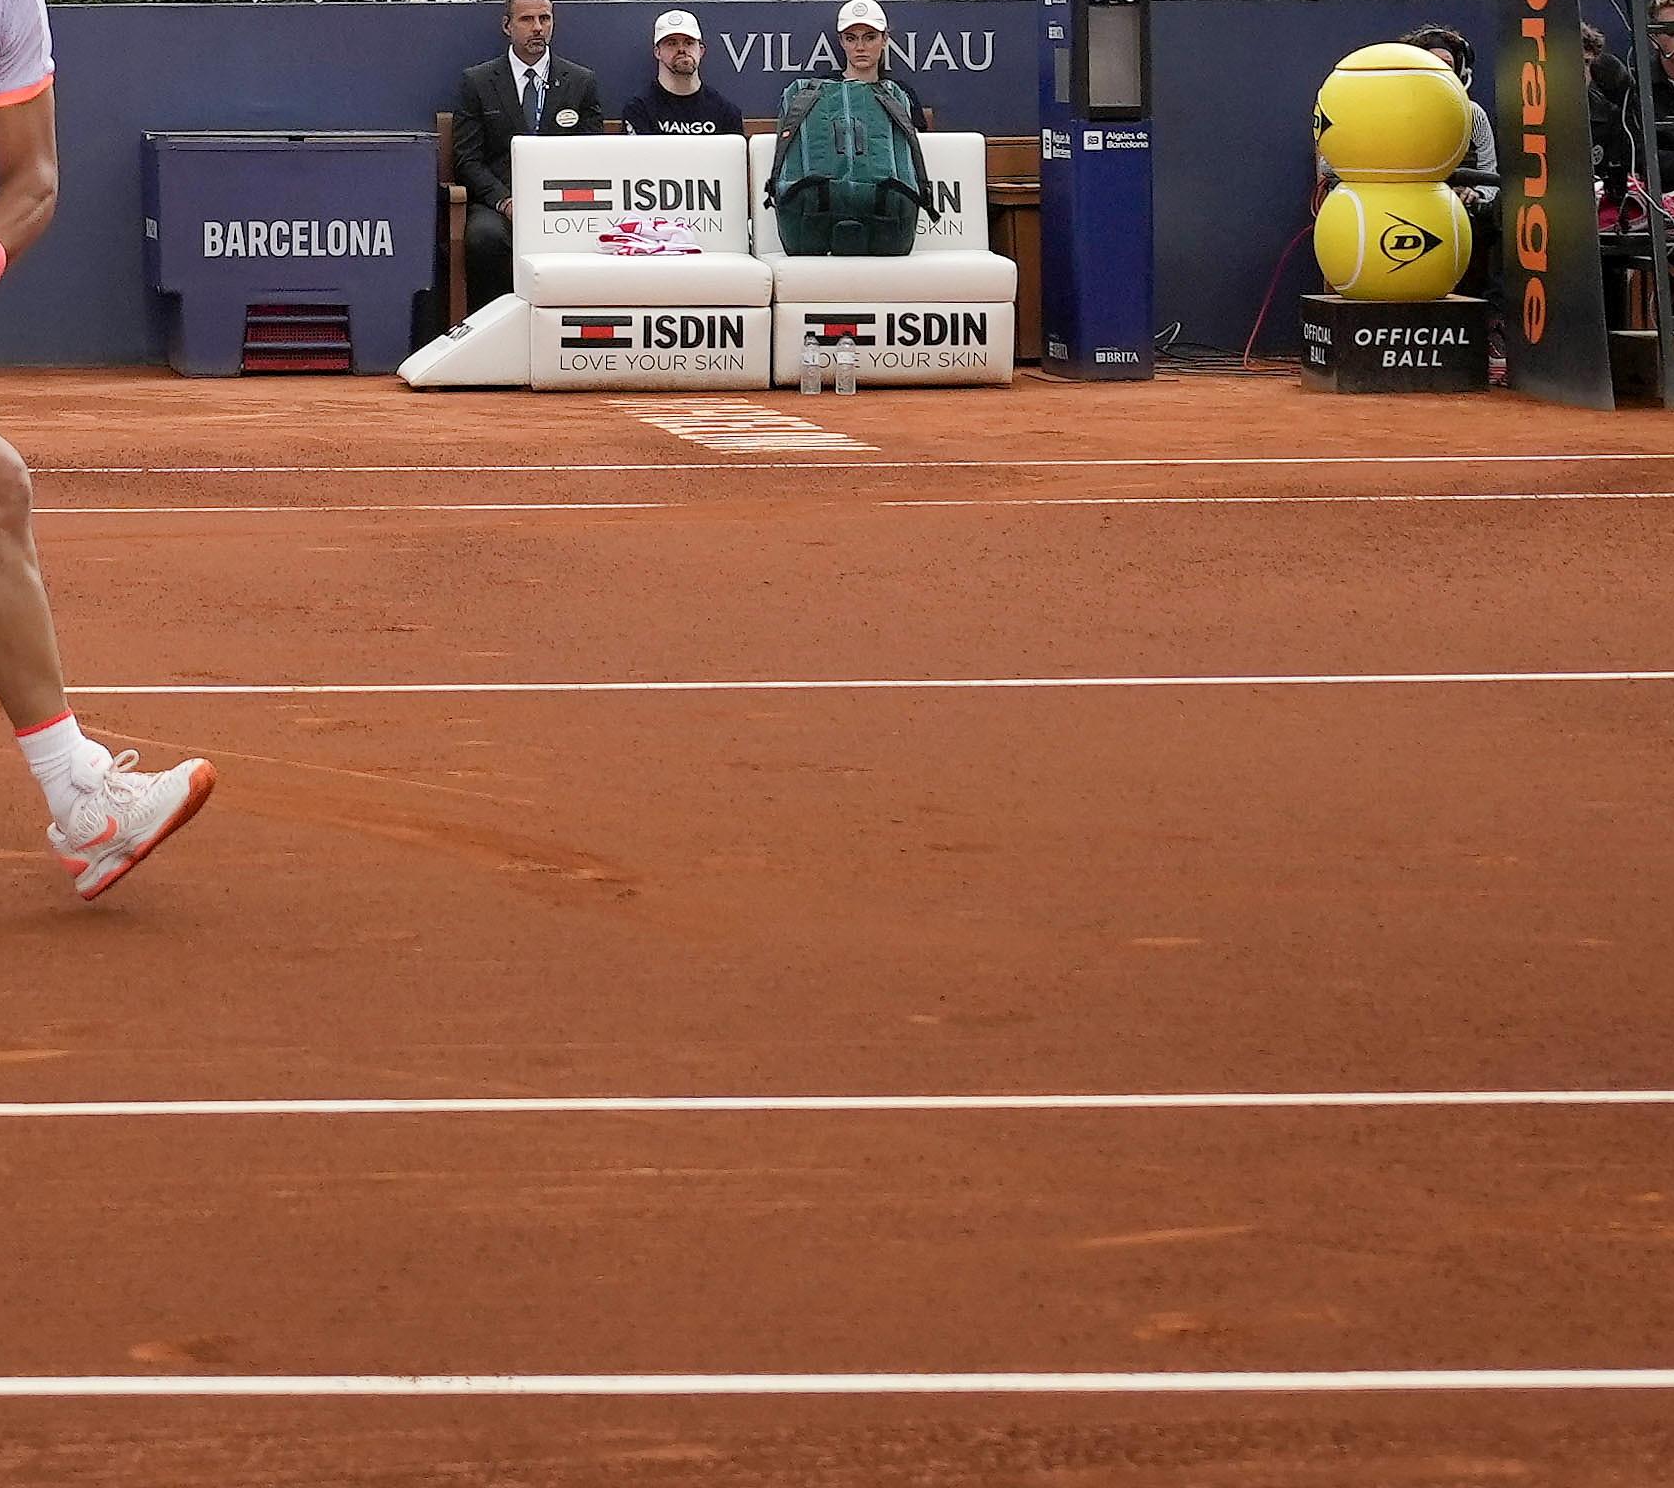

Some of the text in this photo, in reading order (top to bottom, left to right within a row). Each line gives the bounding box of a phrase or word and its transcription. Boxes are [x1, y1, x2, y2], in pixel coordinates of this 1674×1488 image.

[720, 30, 995, 72] VILANAU
[623, 179, 721, 212] ISDIN
[543, 217, 599, 234] LOVE
[203, 220, 394, 258] BARCELONA
[643, 315, 744, 350] ISDIN
[886, 313, 988, 347] ISDIN
[1303, 323, 1333, 346] OFFICIAL
[1354, 327, 1470, 346] OFFICIAL
[560, 354, 744, 371] LOVE YOUR SKIN
[869, 353, 935, 370] YOUR
[941, 352, 988, 369] SKIN
[1106, 351, 1140, 363] BRITA
[1310, 345, 1327, 366] BALL
[1382, 349, 1443, 368] BALL
